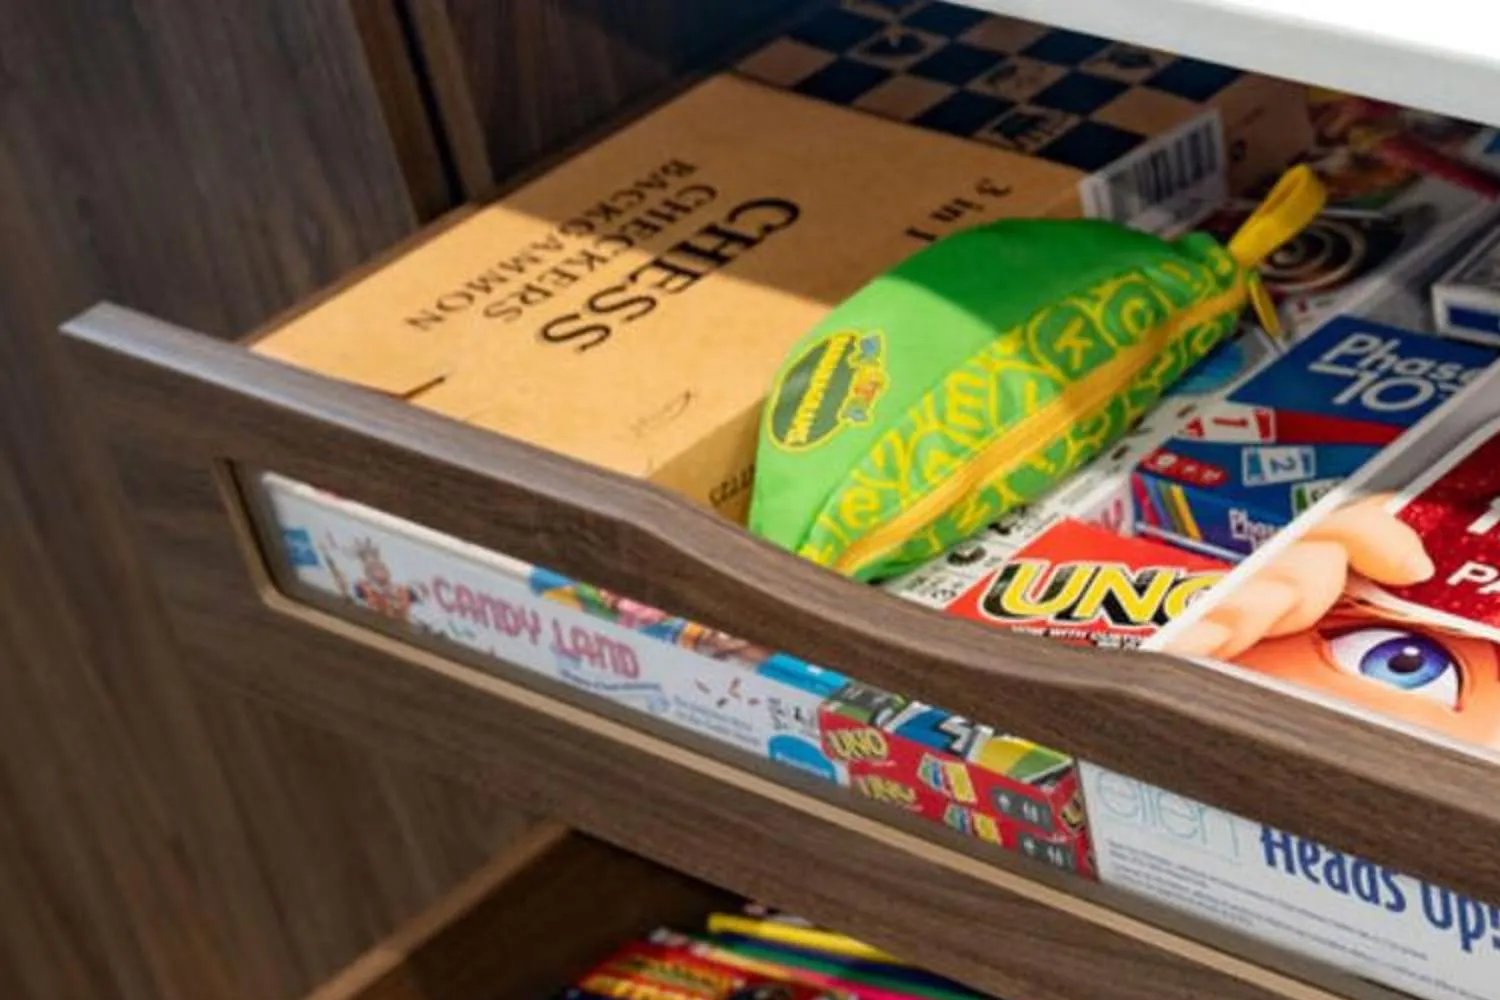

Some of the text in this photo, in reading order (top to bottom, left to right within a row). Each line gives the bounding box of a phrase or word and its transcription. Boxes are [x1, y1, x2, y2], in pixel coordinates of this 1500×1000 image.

[405, 157, 700, 333] BACKGAMMON
[482, 182, 720, 325] CHECKERS
[537, 196, 802, 353] CHESS
[1332, 375, 1435, 412] 10
[430, 575, 542, 646] CANDY
[550, 616, 641, 681] LAND
[826, 728, 889, 764] UNO
